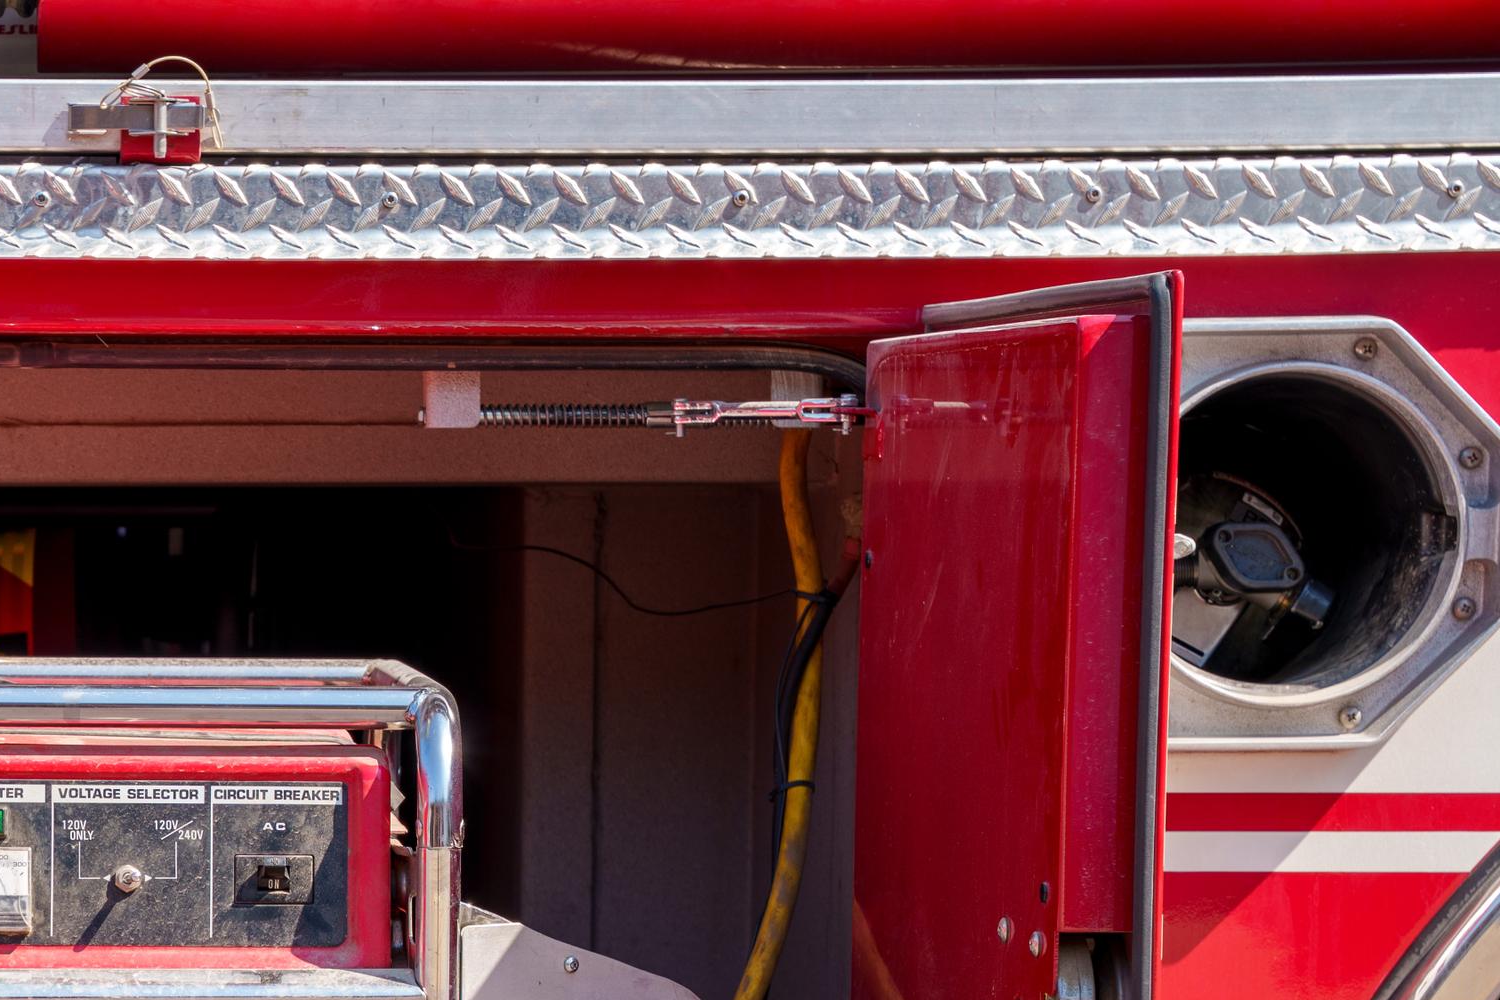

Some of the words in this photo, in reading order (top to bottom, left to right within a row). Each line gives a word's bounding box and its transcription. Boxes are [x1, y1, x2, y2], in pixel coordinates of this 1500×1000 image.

[58, 787, 121, 800] VOLTAGE
[127, 788, 199, 800] SELECTOR
[213, 788, 269, 801] CIRCUIT
[273, 789, 340, 801] BREAKER
[61, 819, 87, 830] 120V
[262, 822, 286, 831] AC
[69, 830, 95, 841] ONLY
[267, 879, 280, 890] ON
